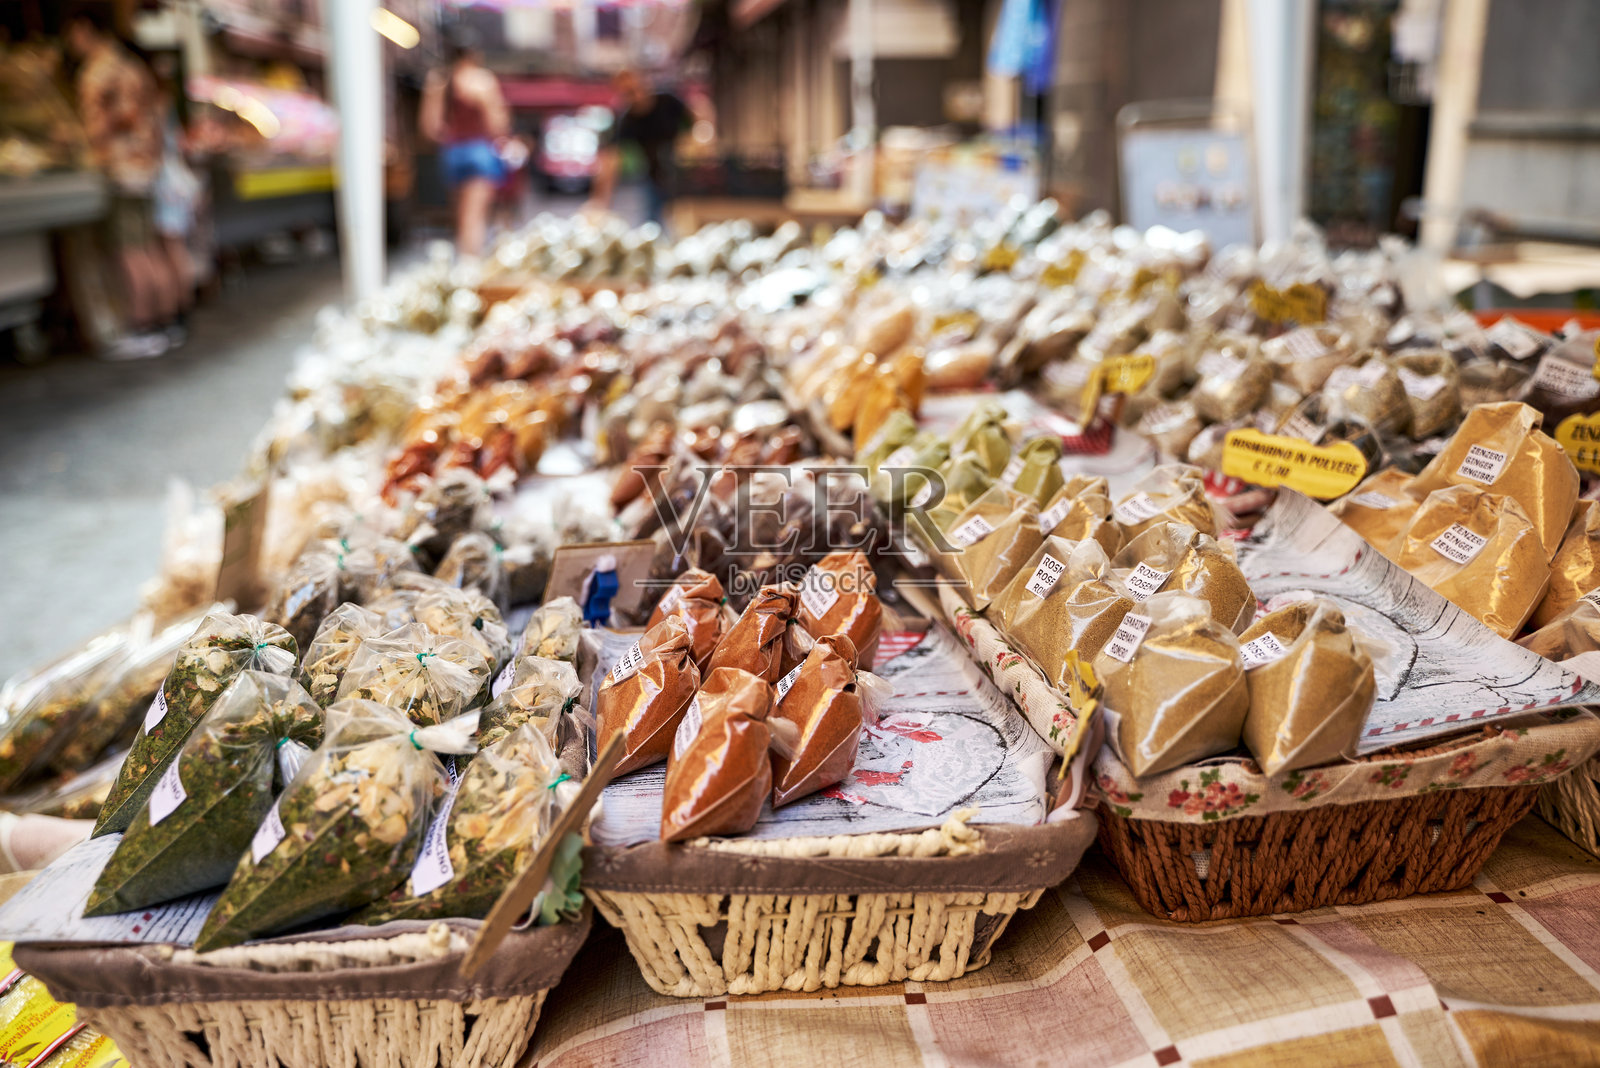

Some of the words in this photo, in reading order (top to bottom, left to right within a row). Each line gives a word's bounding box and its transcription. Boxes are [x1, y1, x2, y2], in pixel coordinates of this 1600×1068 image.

[1571, 423, 1600, 442] ZENZ
[1230, 436, 1292, 459] ROSMARINO
[1295, 450, 1307, 463] IN
[1308, 455, 1361, 476] POLVERE
[1465, 455, 1495, 470] GINGER
[1470, 446, 1504, 463] ZENZERO
[1433, 539, 1470, 562] JENGIBRE
[1443, 531, 1474, 552] GINGER
[1036, 568, 1057, 586] ROSE
[1246, 641, 1266, 659] ROSE
